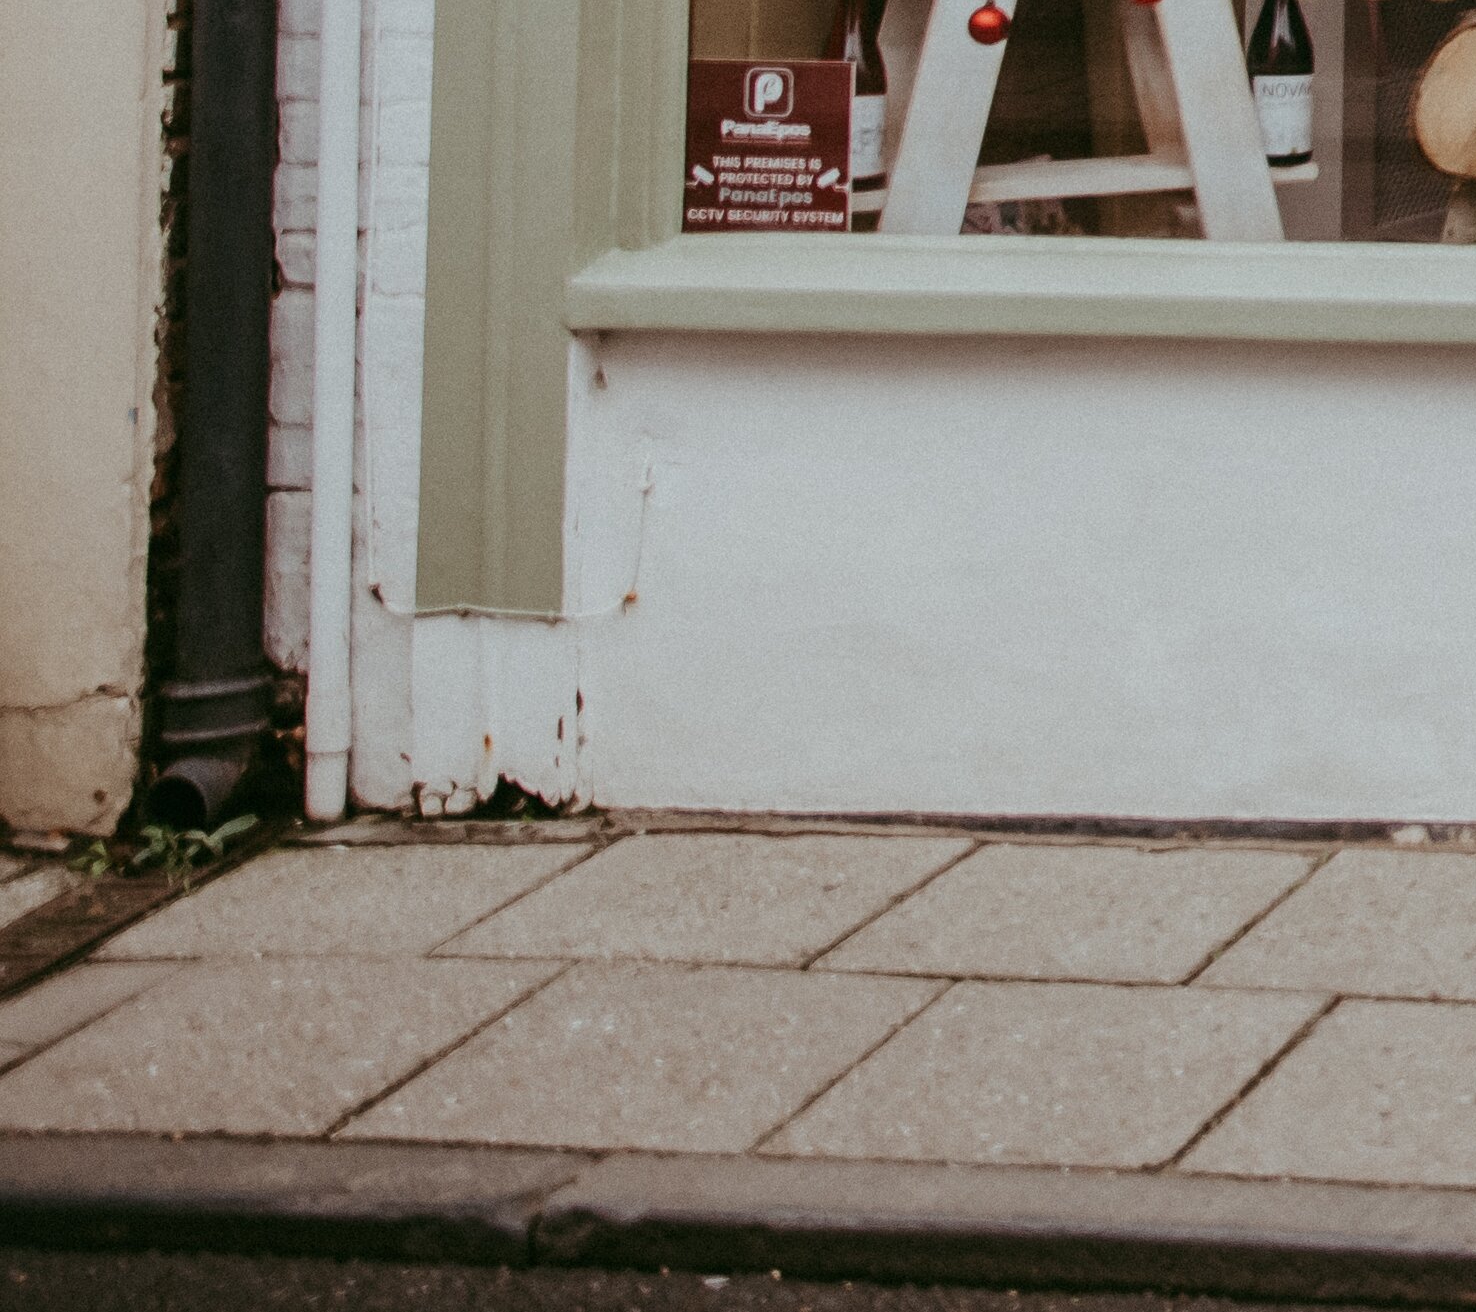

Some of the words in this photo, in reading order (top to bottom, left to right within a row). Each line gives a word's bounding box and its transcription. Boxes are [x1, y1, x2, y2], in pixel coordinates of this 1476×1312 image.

[721, 119, 812, 140] PanaEpos
[713, 156, 741, 168] THIS
[744, 157, 806, 169] PREMISES
[719, 172, 793, 185] PROTECTED
[796, 173, 814, 186] BY
[719, 188, 813, 207] PanaEpos
[687, 208, 724, 221] CCTV
[727, 209, 789, 223] SECURITY
[793, 210, 844, 224] SYSTEM
